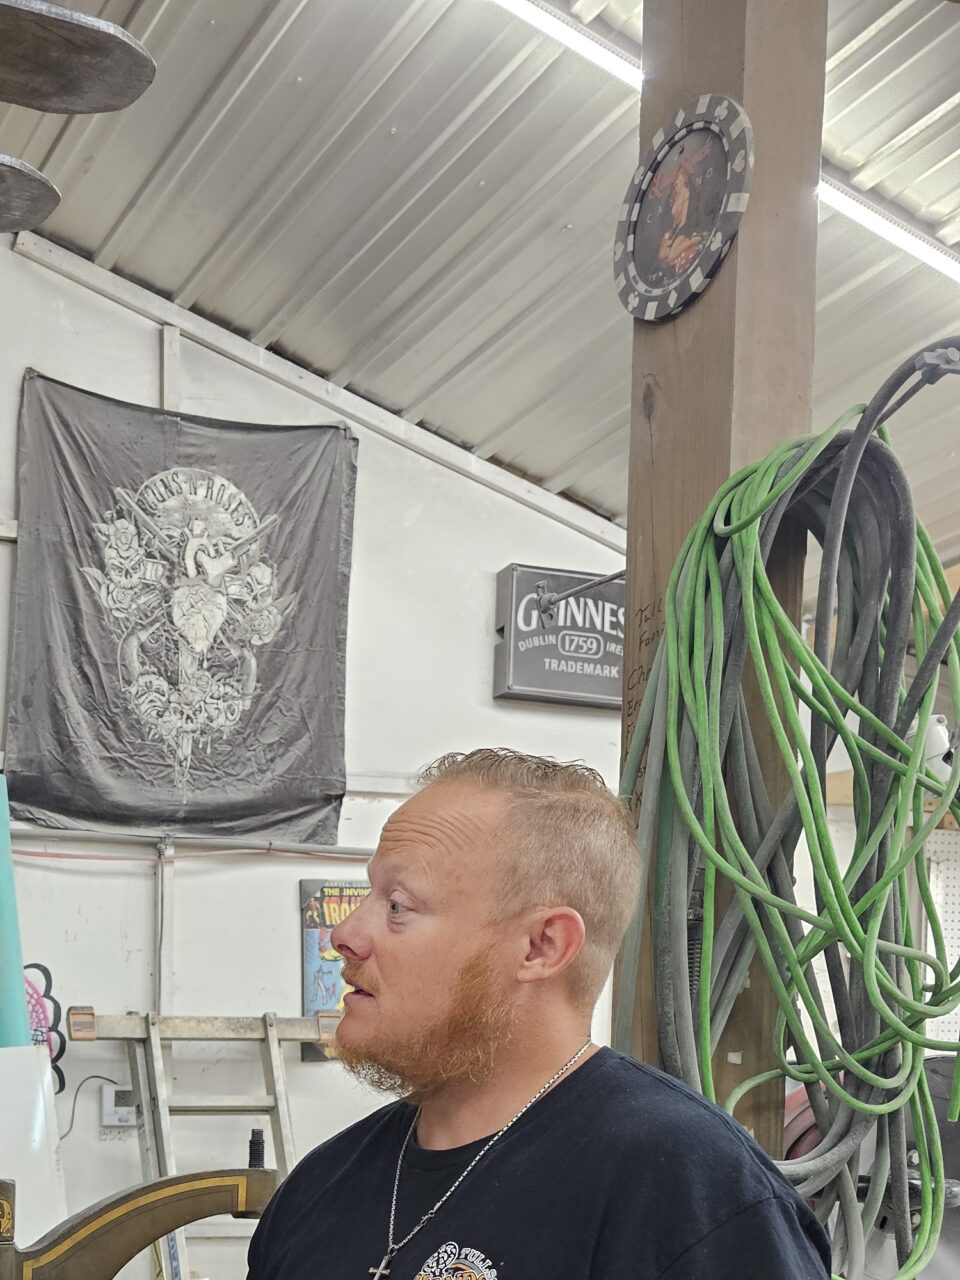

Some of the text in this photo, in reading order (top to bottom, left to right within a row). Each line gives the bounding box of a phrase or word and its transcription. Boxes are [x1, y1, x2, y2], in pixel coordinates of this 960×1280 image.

[517, 593, 625, 639] GINNES
[518, 634, 557, 652] DUBLIN
[564, 635, 597, 654] 1759
[544, 658, 619, 678] TRADEMARK
[323, 888, 340, 896] THE
